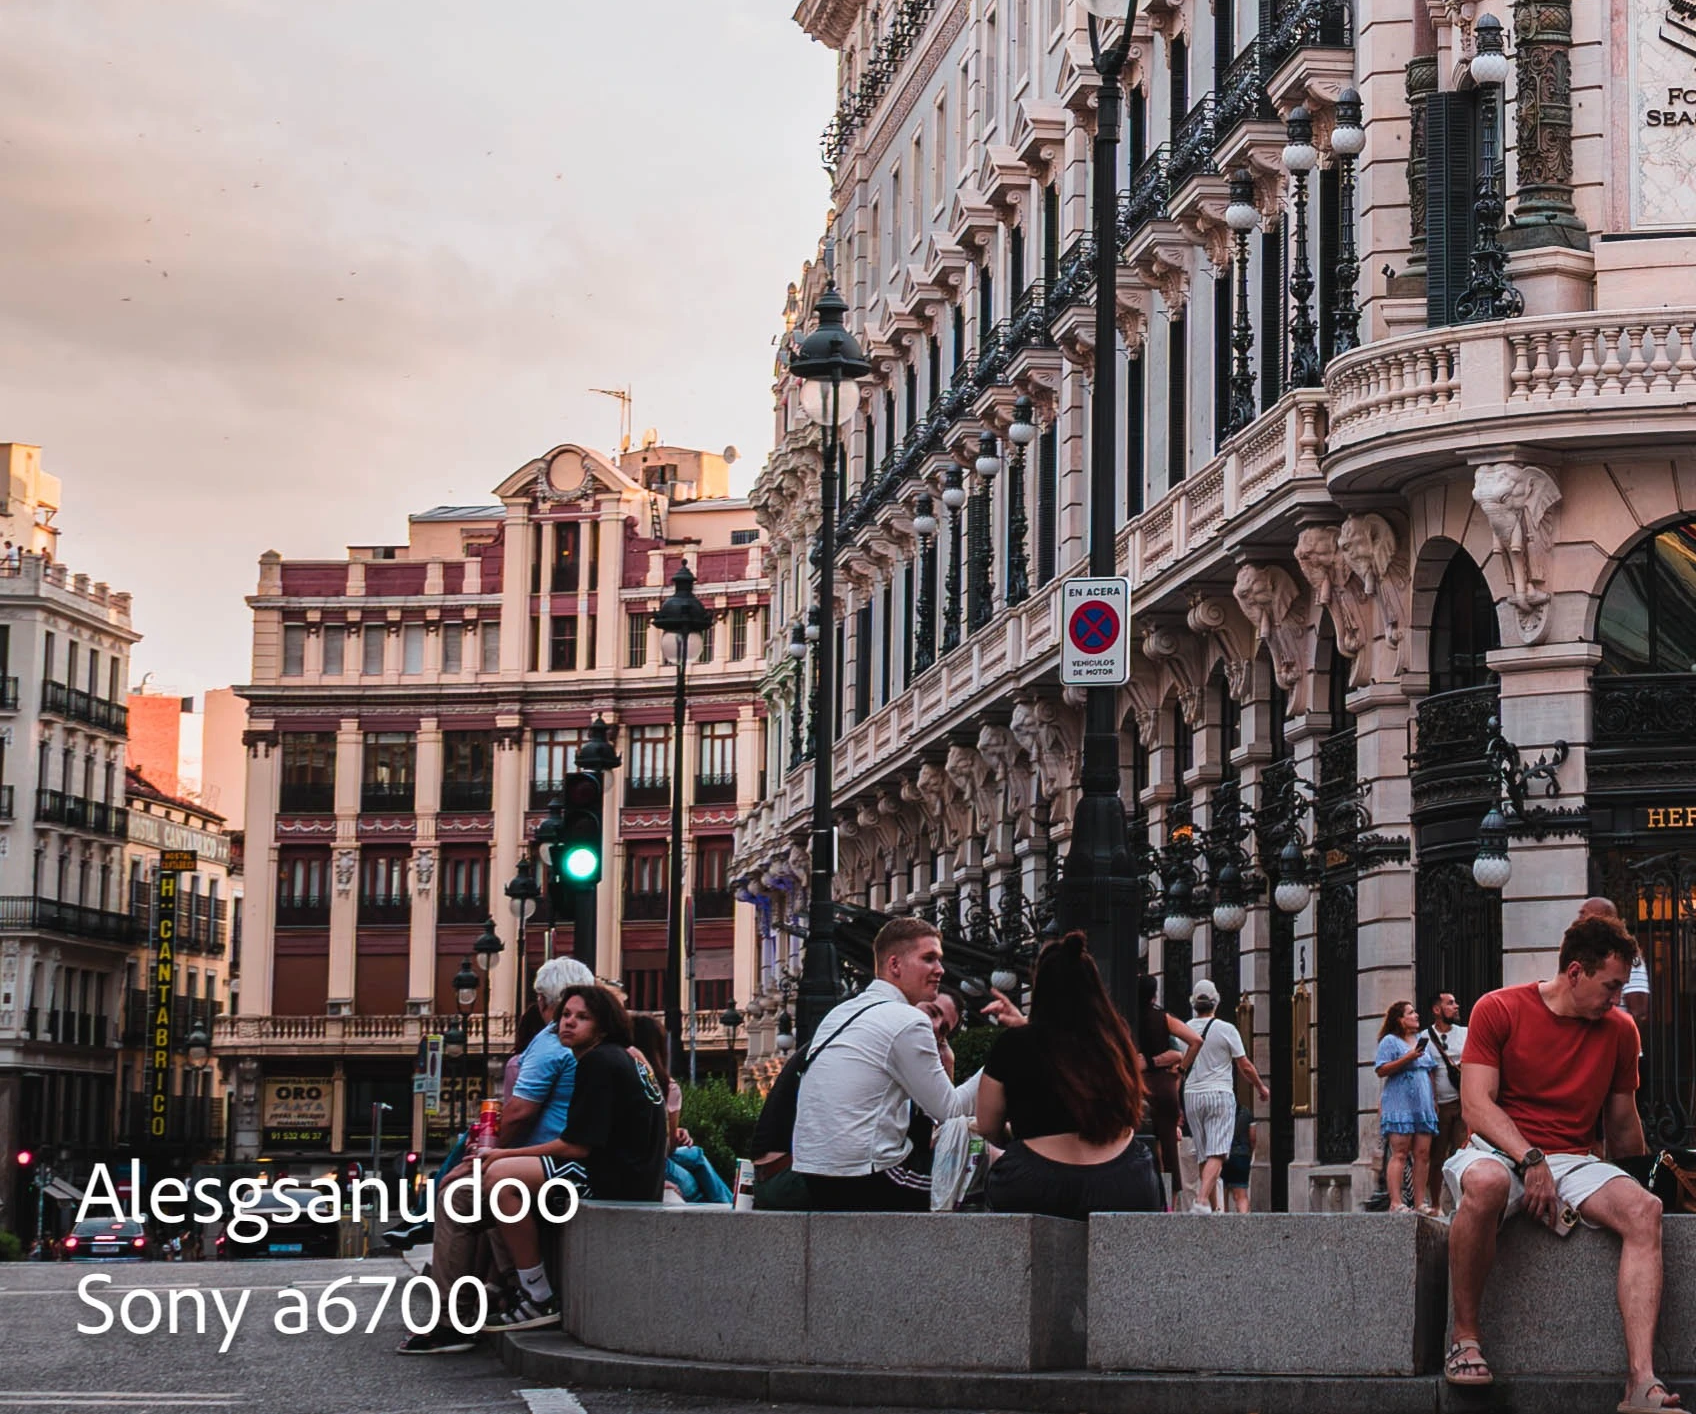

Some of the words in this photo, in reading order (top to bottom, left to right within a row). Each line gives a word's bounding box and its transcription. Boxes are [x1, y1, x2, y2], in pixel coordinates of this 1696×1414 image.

[1069, 588, 1083, 597] EN
[1087, 587, 1121, 597] ACERA
[1086, 668, 1113, 676] MOTOR
[152, 919, 174, 1136] CANTABRICO
[275, 1086, 322, 1100] ORO
